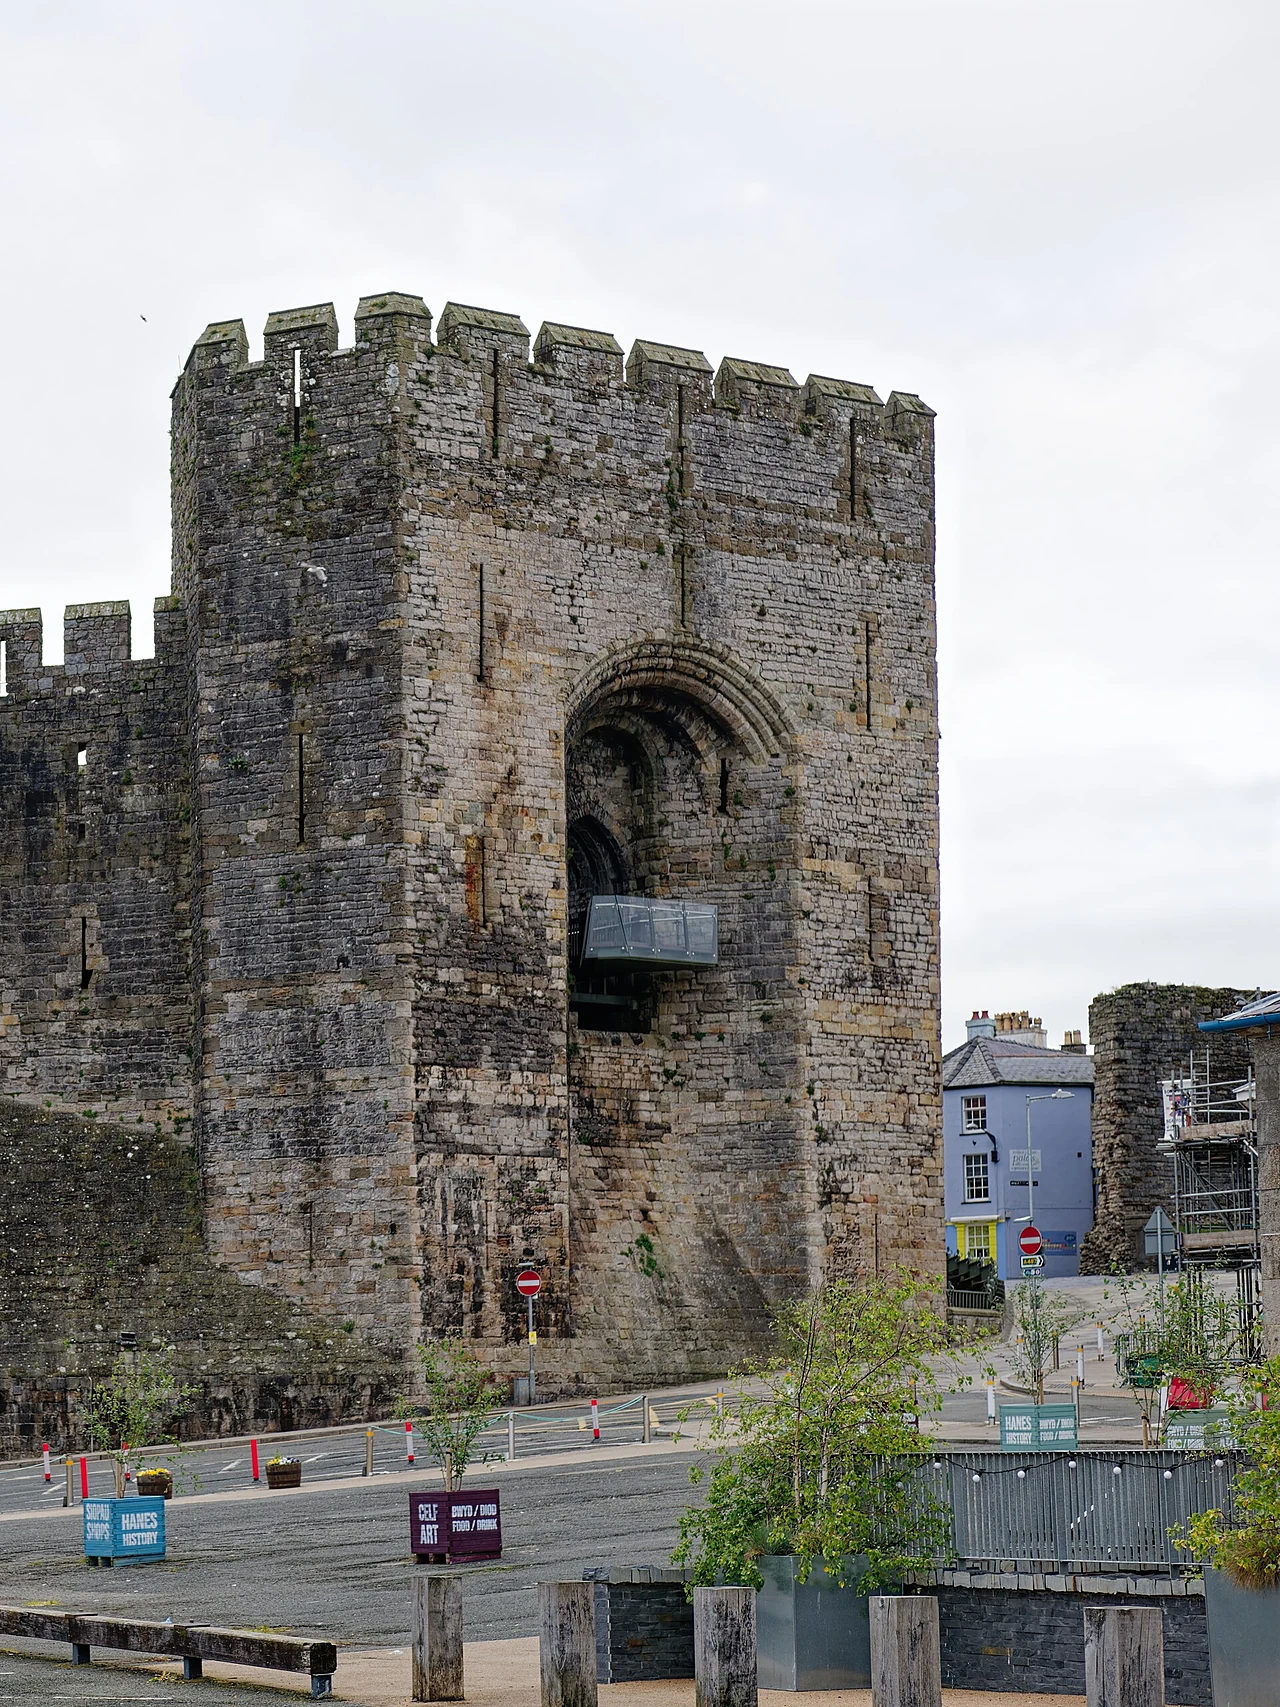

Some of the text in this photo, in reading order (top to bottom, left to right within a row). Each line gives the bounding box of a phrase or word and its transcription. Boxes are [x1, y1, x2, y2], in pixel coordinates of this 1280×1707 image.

[1005, 1416, 1032, 1430] HANES
[1056, 1419, 1061, 1429] /
[1006, 1432, 1032, 1444] HISTORY
[1040, 1431, 1054, 1441] FOOD
[1054, 1431, 1058, 1440] /
[86, 1503, 109, 1520] SIOPAU
[418, 1504, 438, 1521] CELF
[451, 1504, 497, 1518] BWYD / DIOD
[122, 1512, 158, 1530] HANES
[452, 1518, 498, 1533] FOOD / DRINK
[86, 1522, 110, 1540] SHOPS
[122, 1531, 158, 1546] HISTORY
[420, 1524, 439, 1544] ART
